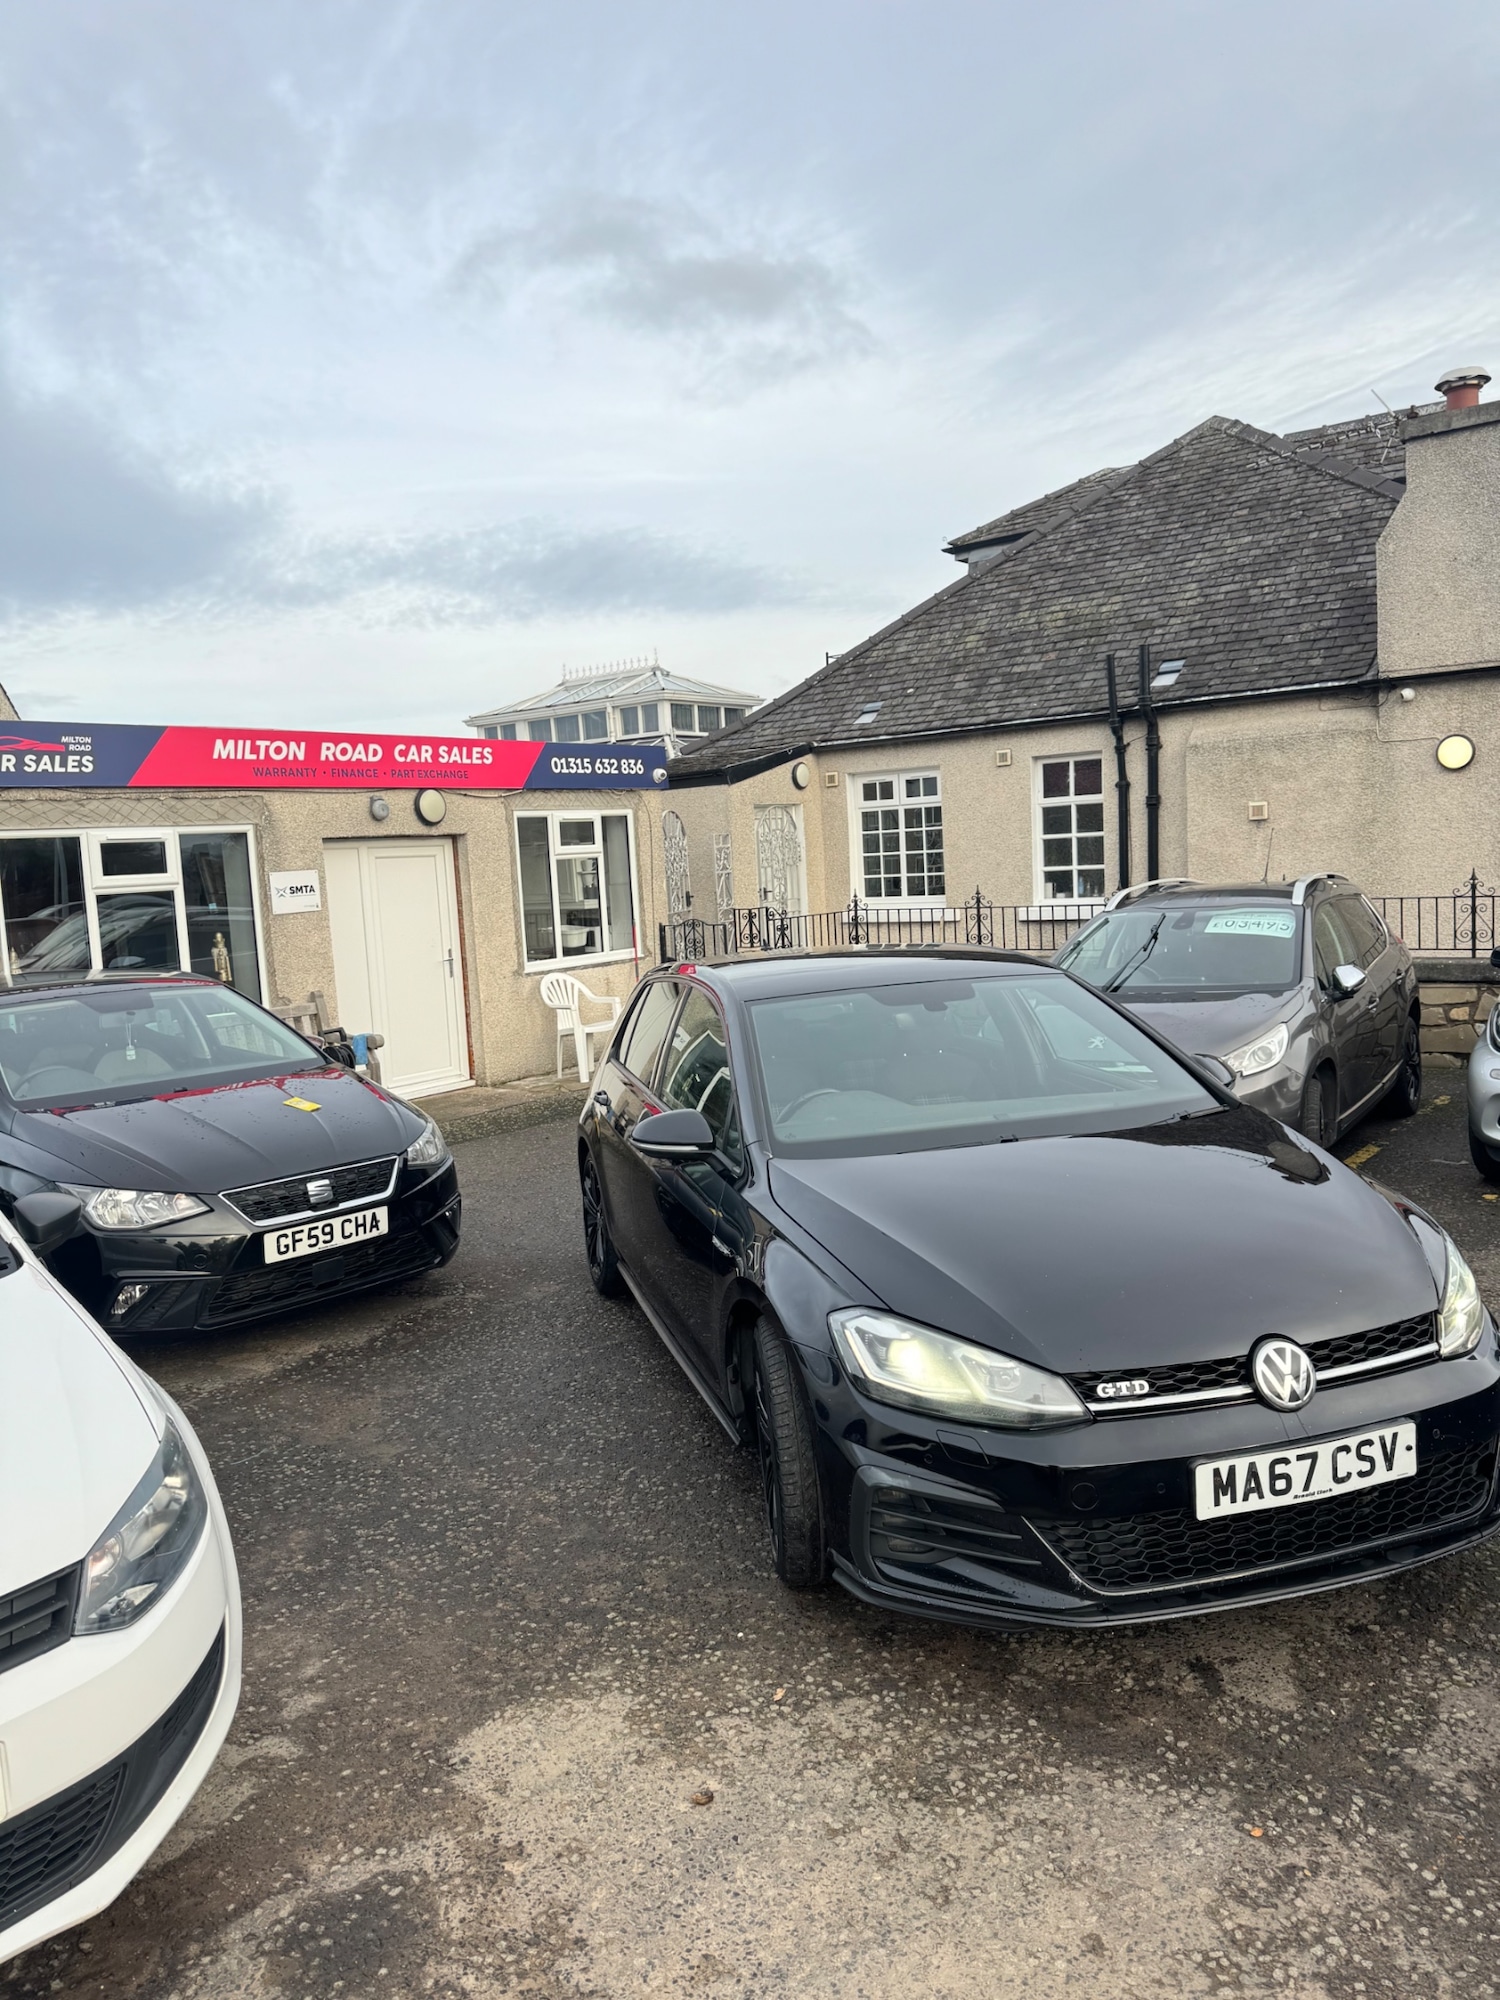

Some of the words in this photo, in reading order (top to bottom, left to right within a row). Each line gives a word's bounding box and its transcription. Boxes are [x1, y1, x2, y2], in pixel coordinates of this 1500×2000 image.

[61, 736, 92, 744] MILTON
[68, 744, 92, 752] ROAD
[212, 738, 306, 761] MILTON
[320, 742, 383, 763] ROAD
[393, 744, 433, 764] CAR
[438, 745, 493, 765] SALES
[23, 755, 94, 773] SALES
[551, 757, 592, 774] 01315
[595, 758, 619, 774] 632
[621, 759, 644, 775] 836
[252, 767, 317, 778] WARRANTY
[331, 768, 379, 779] FINANCE
[391, 769, 415, 780] PART
[418, 770, 469, 781] EXCHANGE
[289, 885, 316, 895] SMTA
[276, 1223, 333, 1255] GF59
[341, 1211, 380, 1239] CHA
[1096, 1380, 1150, 1398] GTD
[1212, 1451, 1318, 1507] MA67
[1331, 1432, 1399, 1484] CSV
